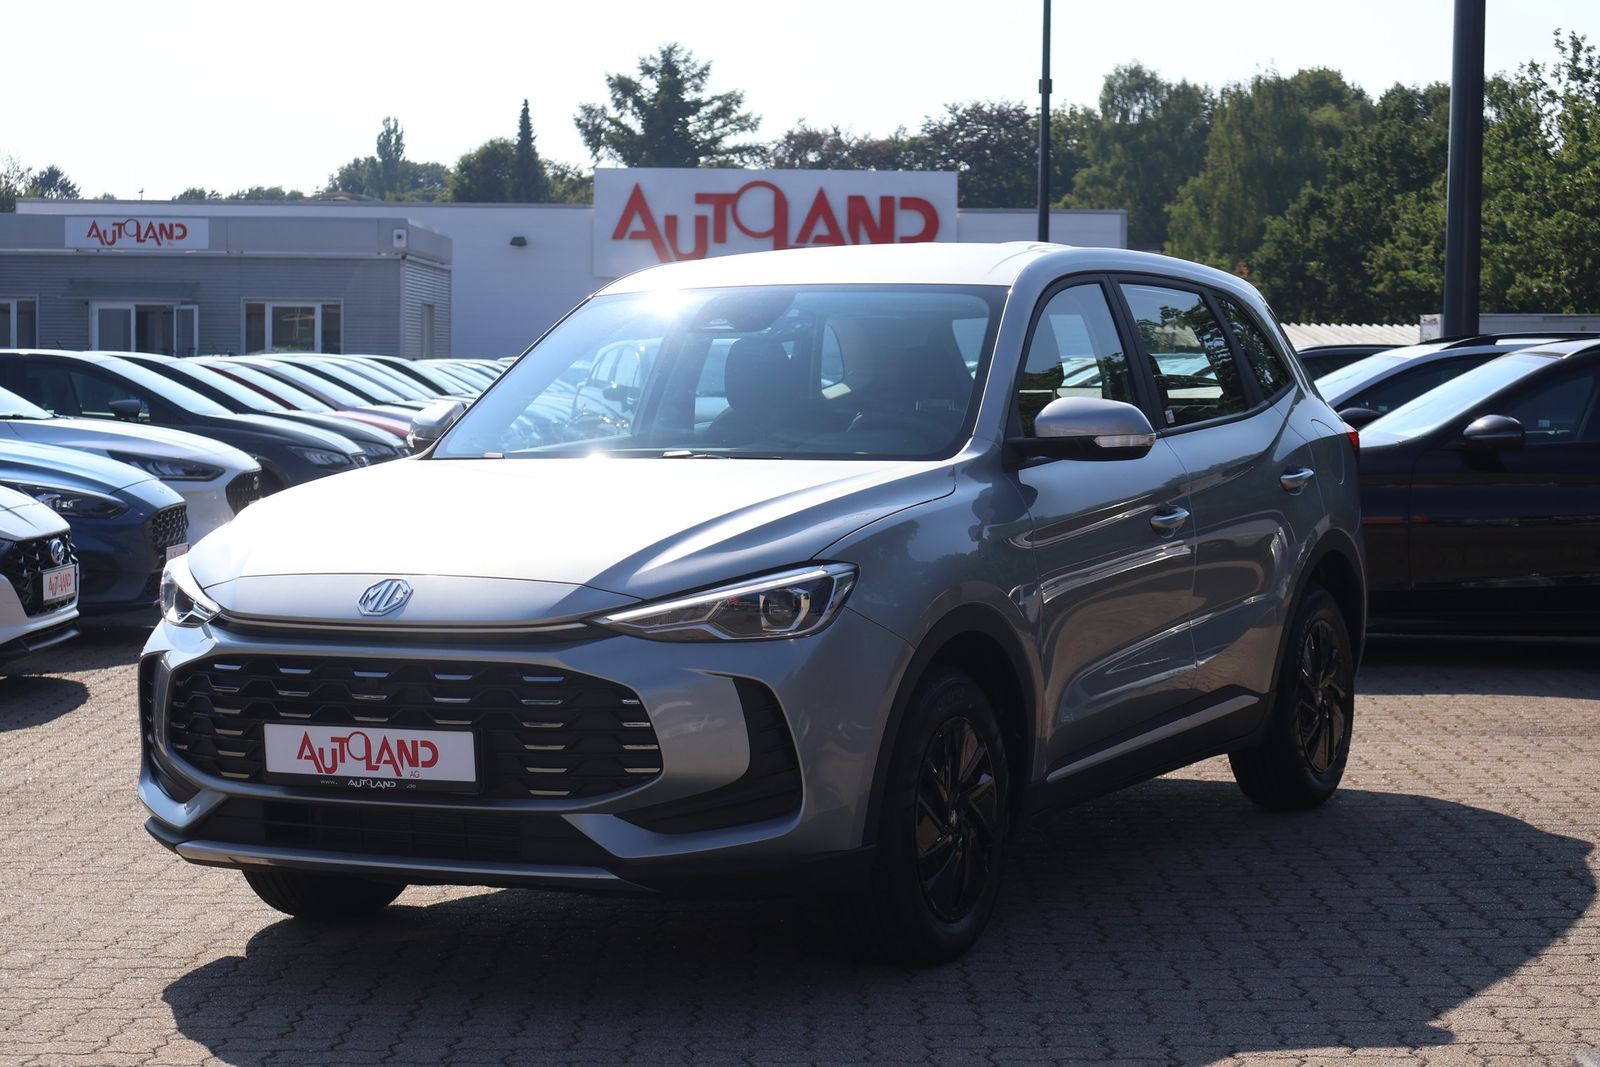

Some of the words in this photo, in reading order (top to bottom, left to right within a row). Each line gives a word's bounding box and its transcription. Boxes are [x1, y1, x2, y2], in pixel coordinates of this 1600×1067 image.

[86, 218, 188, 247] AUTOLAND
[612, 181, 940, 263] AUTOLAND
[357, 579, 413, 616] MG
[296, 731, 439, 777] AUTOLAND
[347, 779, 397, 789] AUTOLAND
[409, 770, 420, 779] AG
